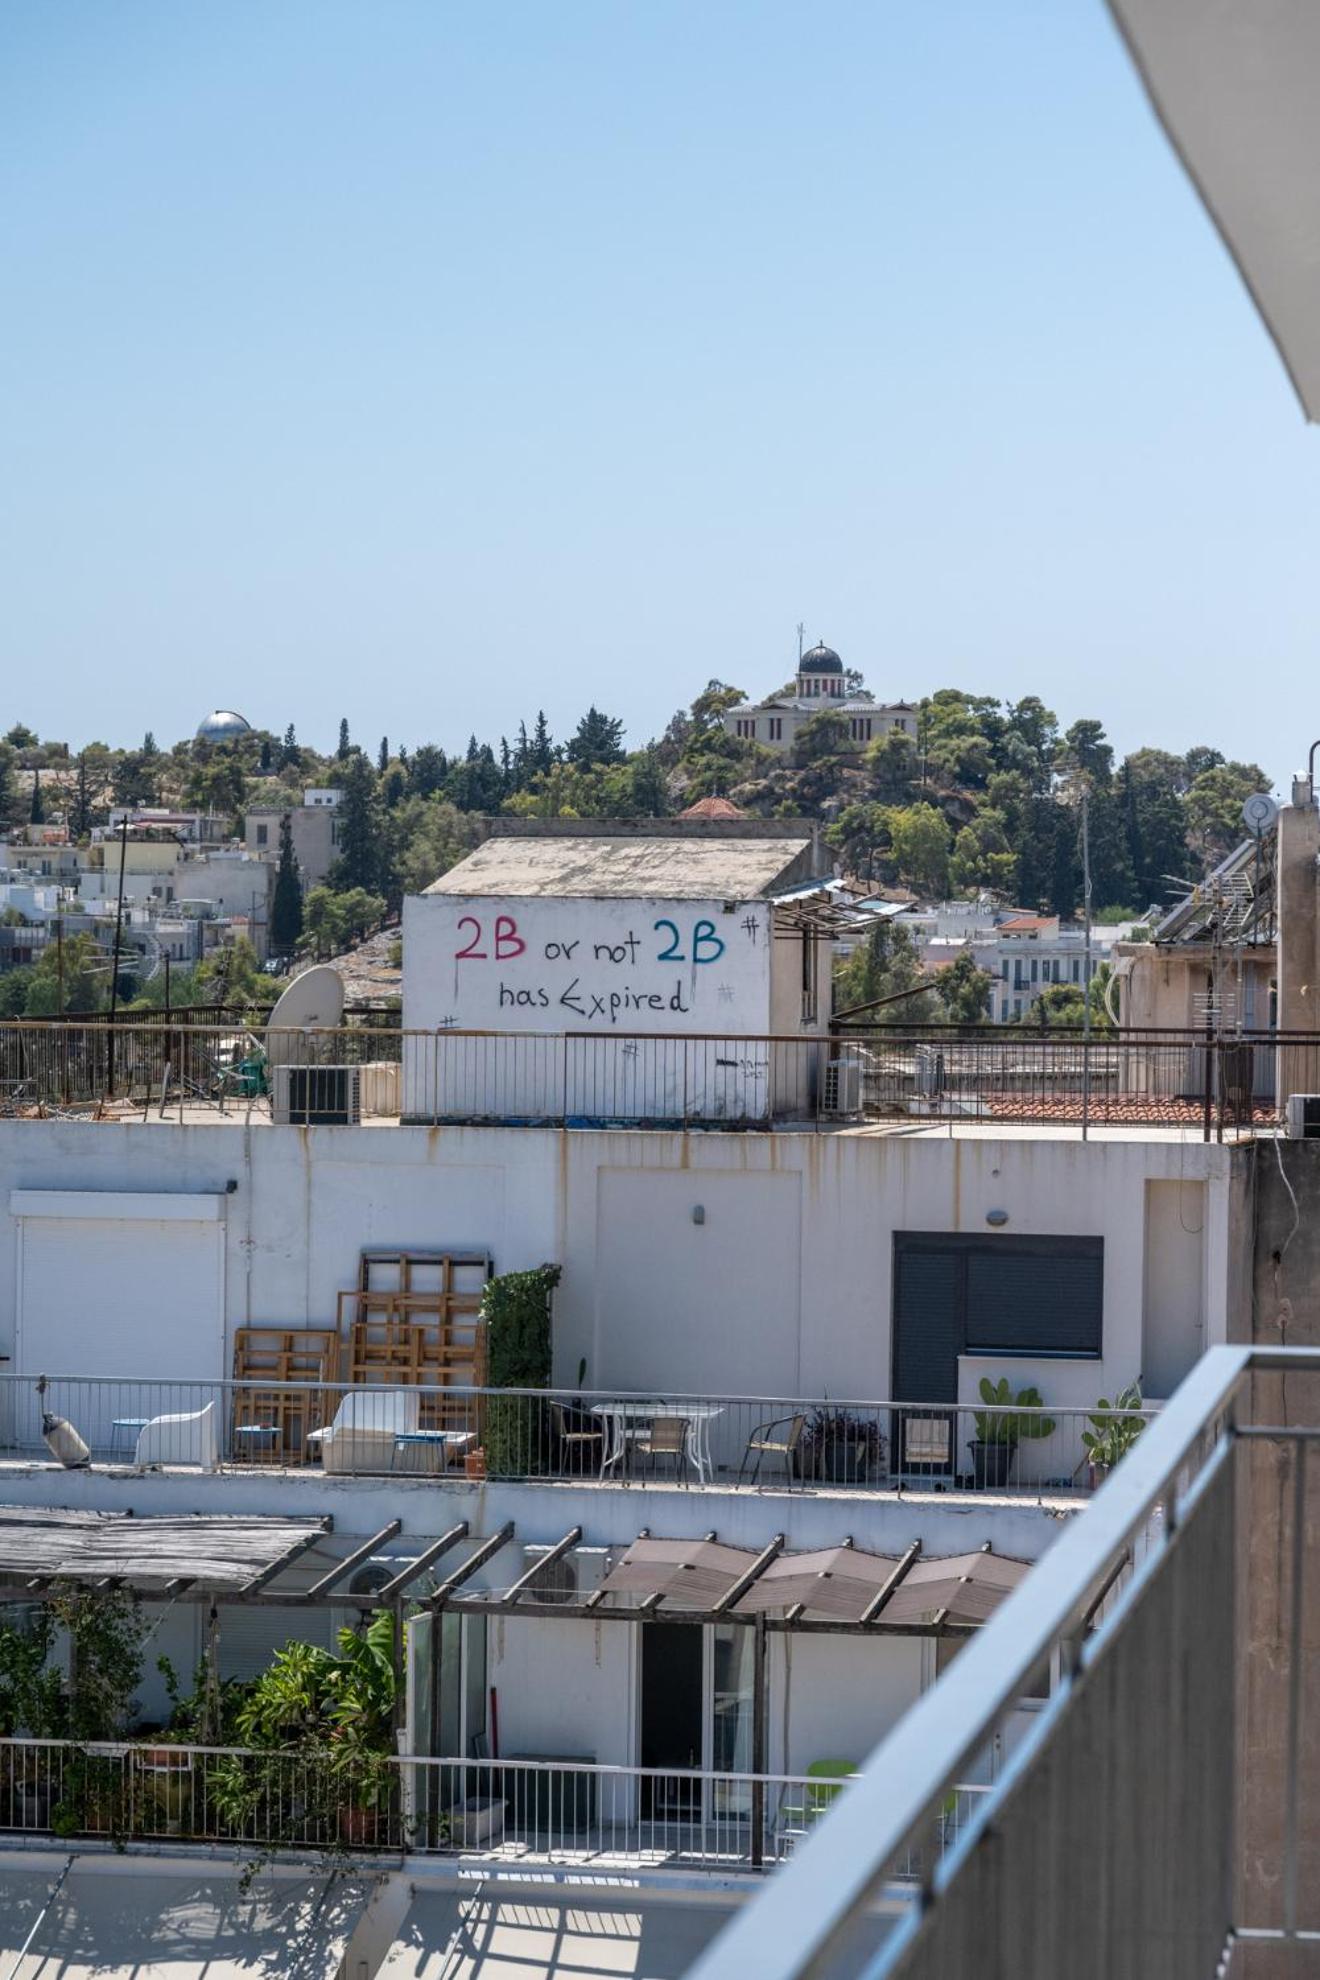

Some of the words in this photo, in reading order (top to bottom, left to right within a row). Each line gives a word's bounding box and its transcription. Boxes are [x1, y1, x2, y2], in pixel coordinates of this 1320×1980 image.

[455, 915, 526, 960] 2B
[544, 940, 580, 960] or
[593, 930, 641, 964] not
[653, 919, 726, 963] 2B
[499, 981, 550, 1007] has
[559, 977, 690, 1024] Expired
